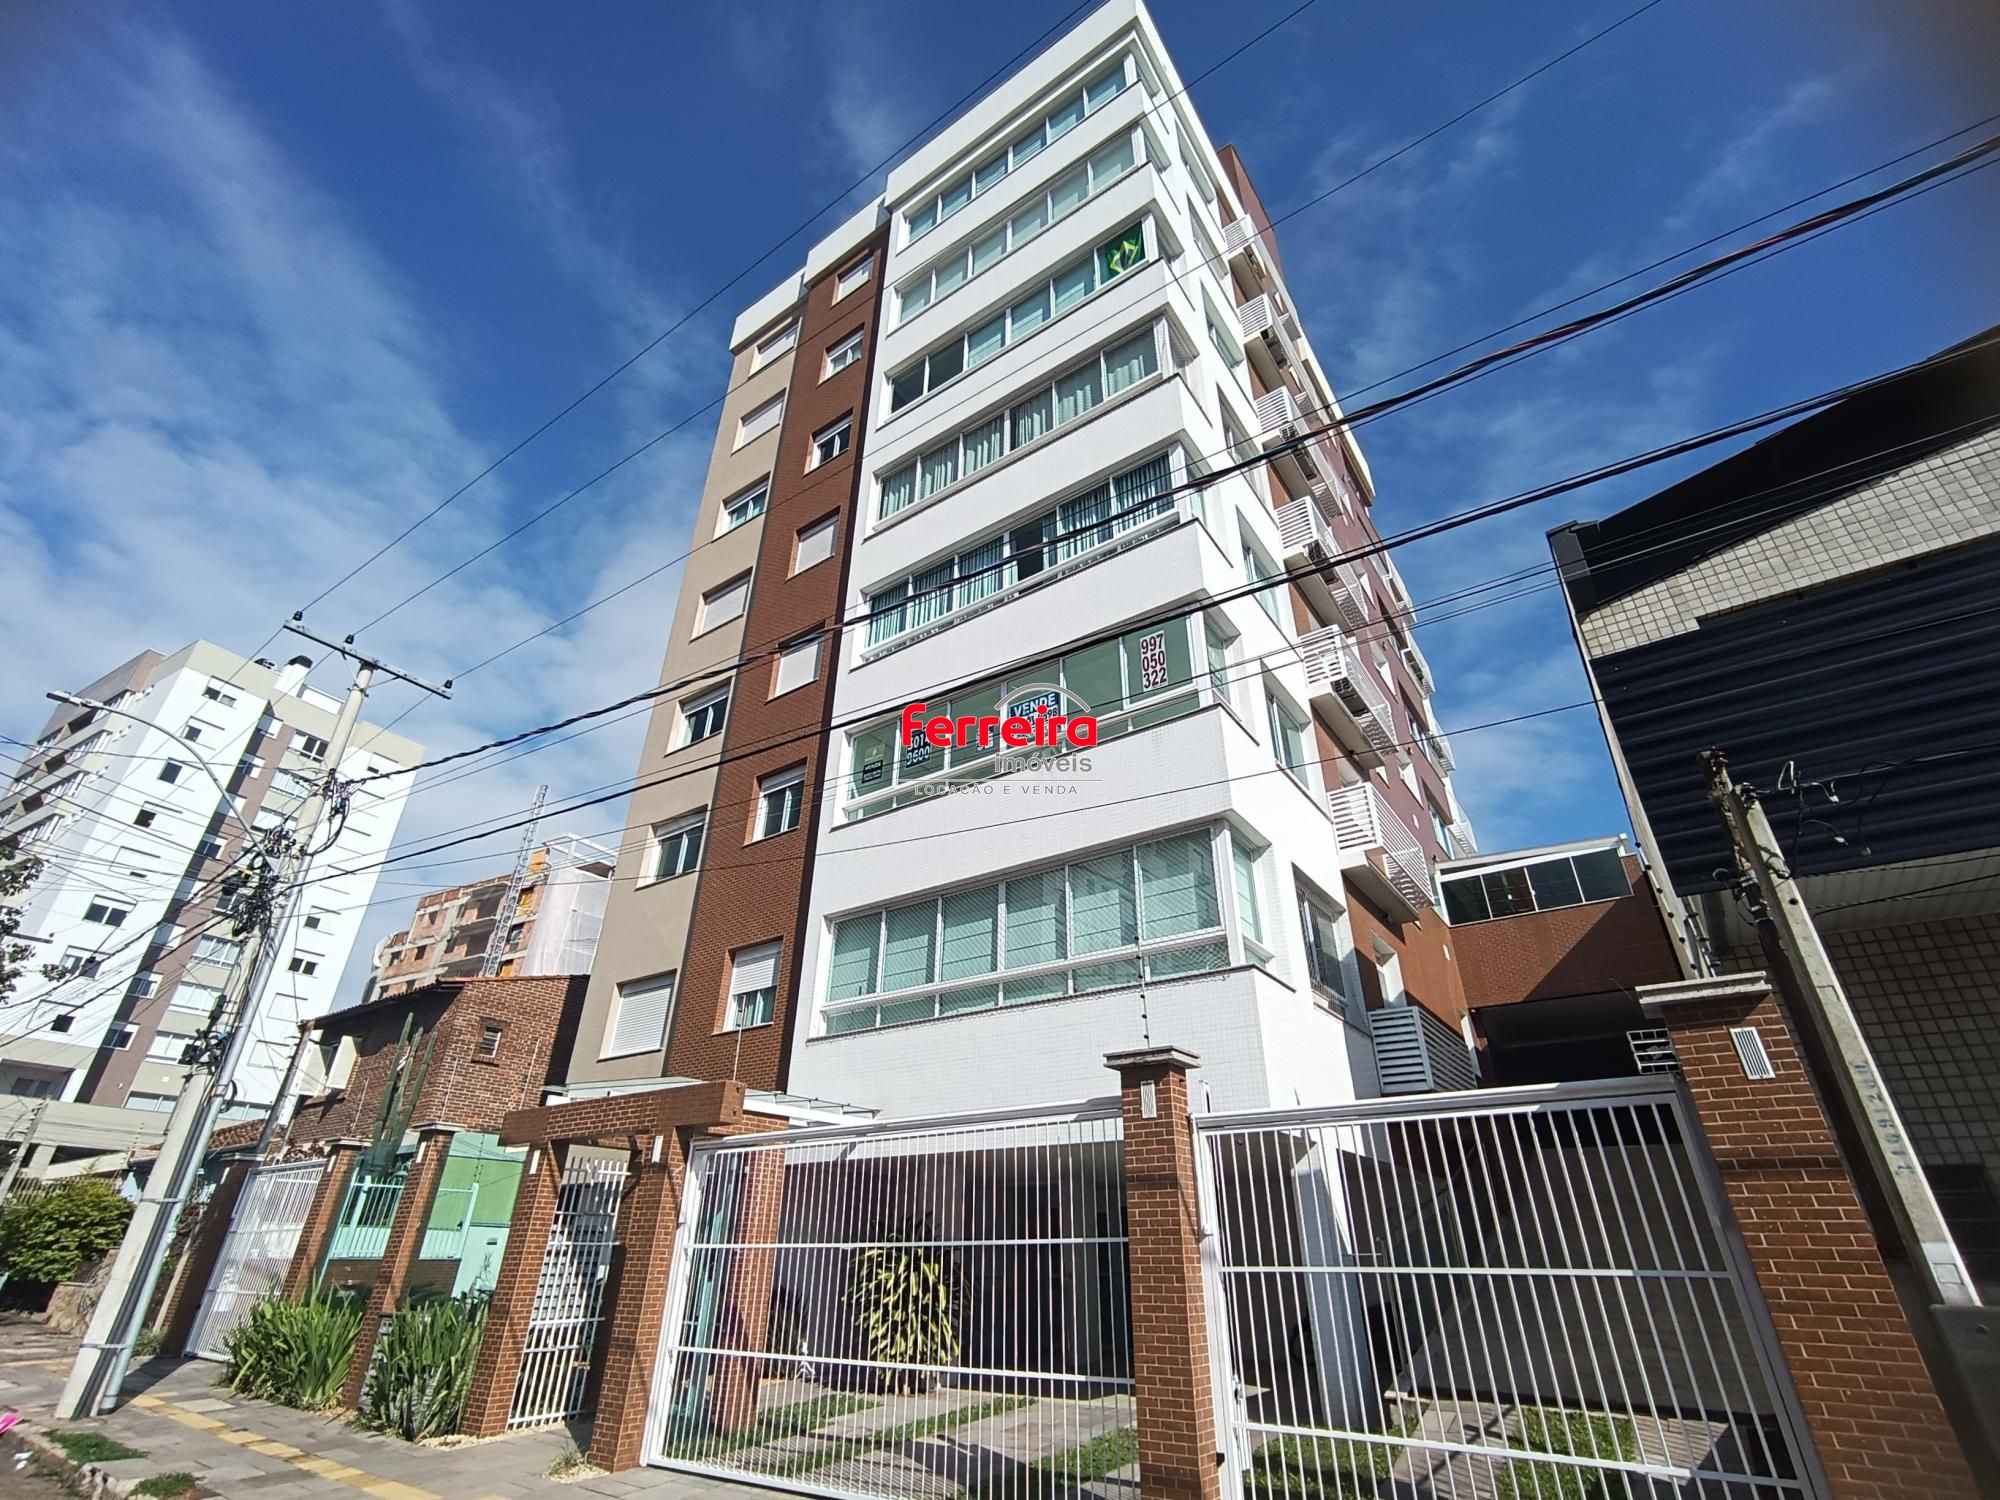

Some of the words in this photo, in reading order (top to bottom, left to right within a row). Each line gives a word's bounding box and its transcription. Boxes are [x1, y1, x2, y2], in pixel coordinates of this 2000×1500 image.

[1141, 633, 1164, 655] 997
[1142, 650, 1166, 672] 050
[1143, 667, 1167, 689] 322
[1013, 693, 1056, 717] VENDE
[906, 745, 930, 765] 9600
